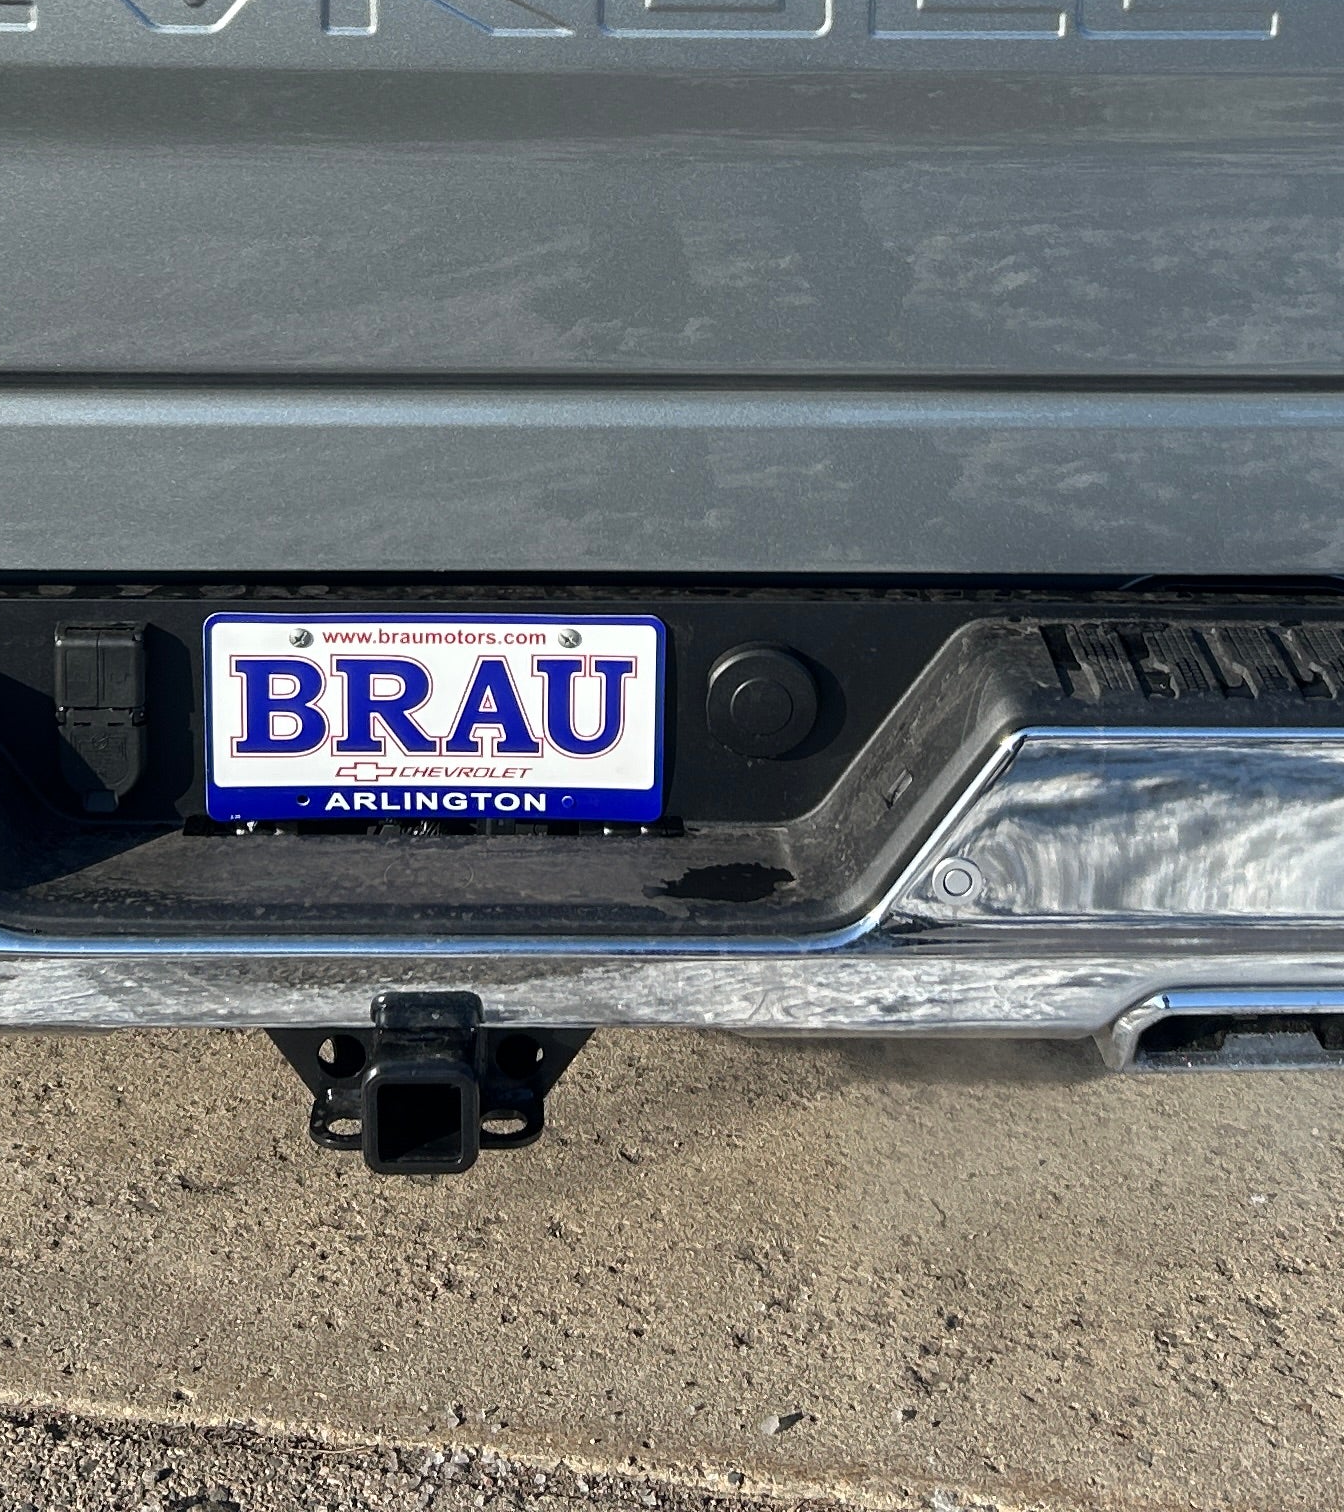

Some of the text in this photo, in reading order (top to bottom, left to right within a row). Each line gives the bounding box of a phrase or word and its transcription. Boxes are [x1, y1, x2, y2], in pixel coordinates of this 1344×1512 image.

[323, 628, 547, 646] www.braumotors.com
[230, 655, 638, 759] BRAU
[398, 766, 533, 780] CHEVROLET
[324, 792, 547, 812] ARLINGTON
